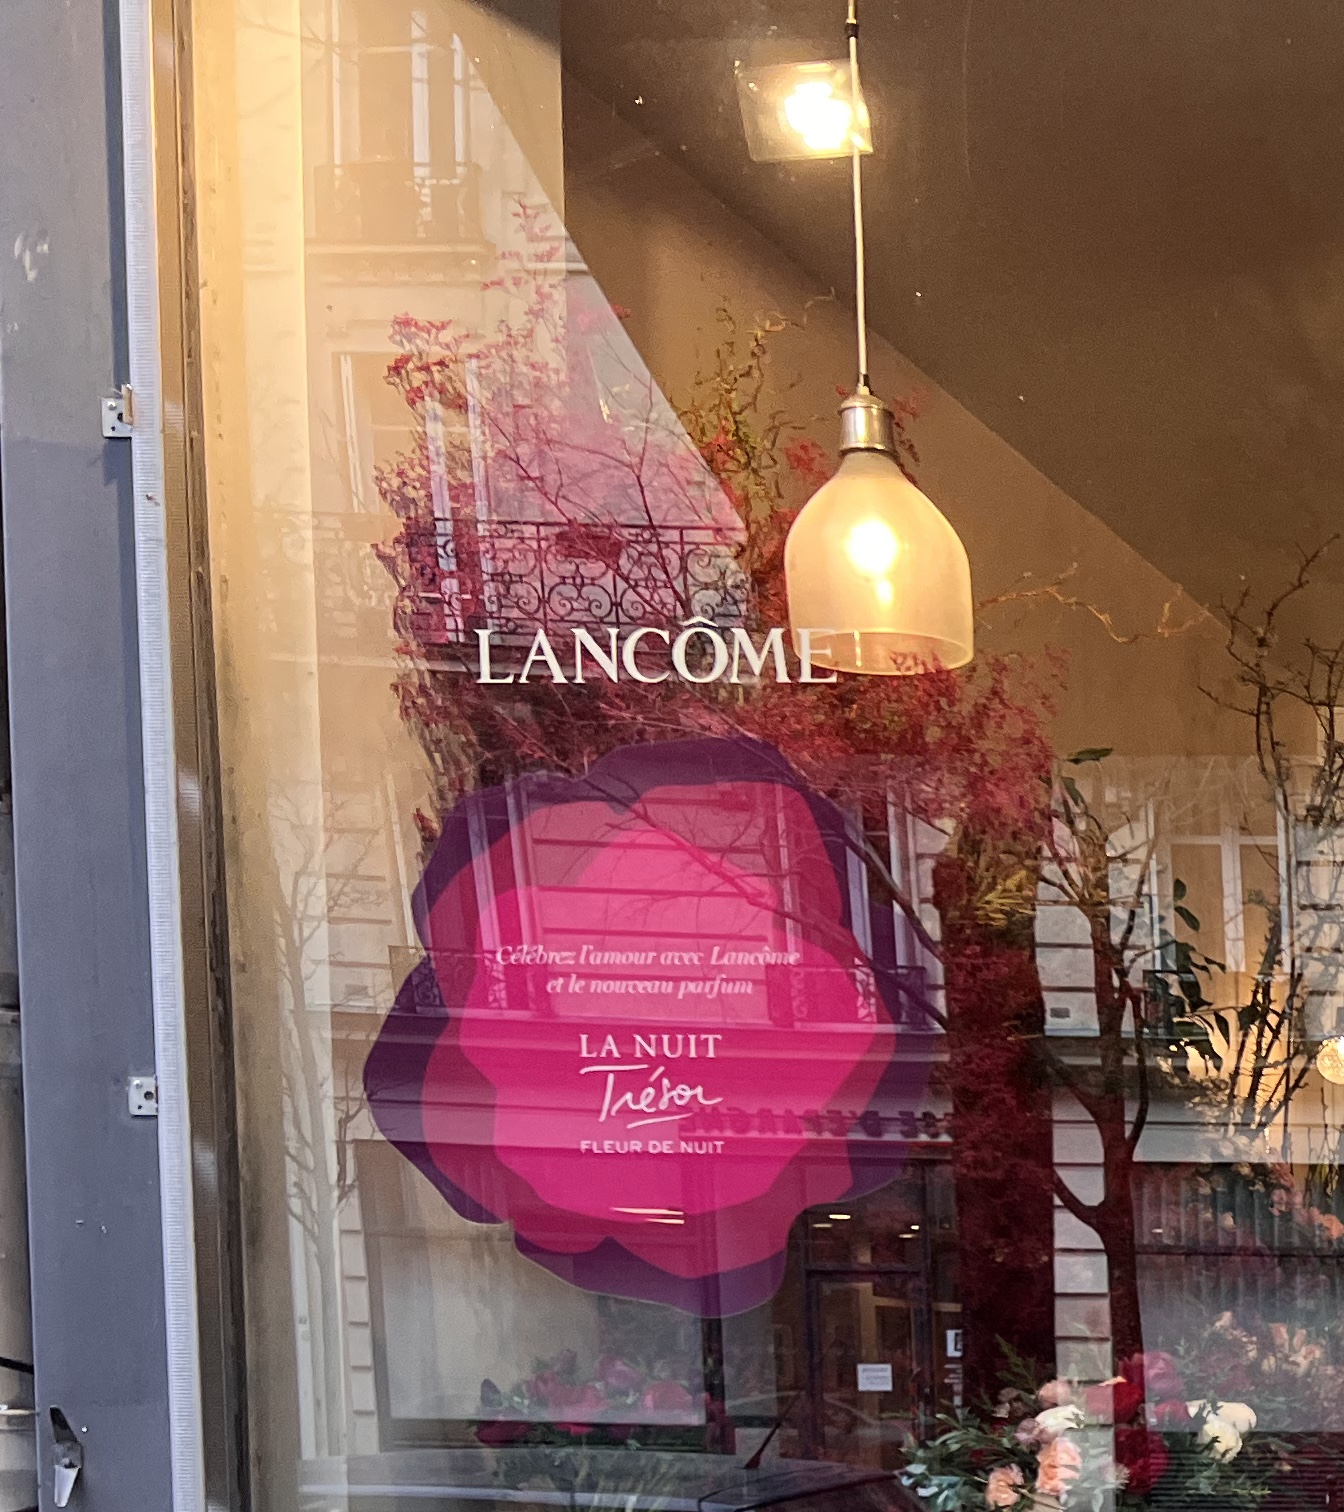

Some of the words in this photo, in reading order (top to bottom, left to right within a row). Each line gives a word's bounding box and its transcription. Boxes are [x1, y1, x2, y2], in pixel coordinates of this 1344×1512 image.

[474, 616, 838, 684] LANCÔME
[496, 945, 575, 965] Célébrez
[579, 945, 656, 965] l'amour
[660, 953, 704, 966] avec
[709, 945, 800, 966] Lancôme
[546, 977, 567, 994] et
[567, 974, 586, 994] le
[589, 979, 674, 994] nouveau
[677, 974, 754, 999] parfum
[579, 1033, 621, 1059] LA
[634, 1033, 722, 1059] NUIT
[579, 1065, 724, 1128] Trésor
[580, 1140, 643, 1155] FLEUR
[648, 1140, 674, 1155] DE
[679, 1140, 725, 1155] NUIT
